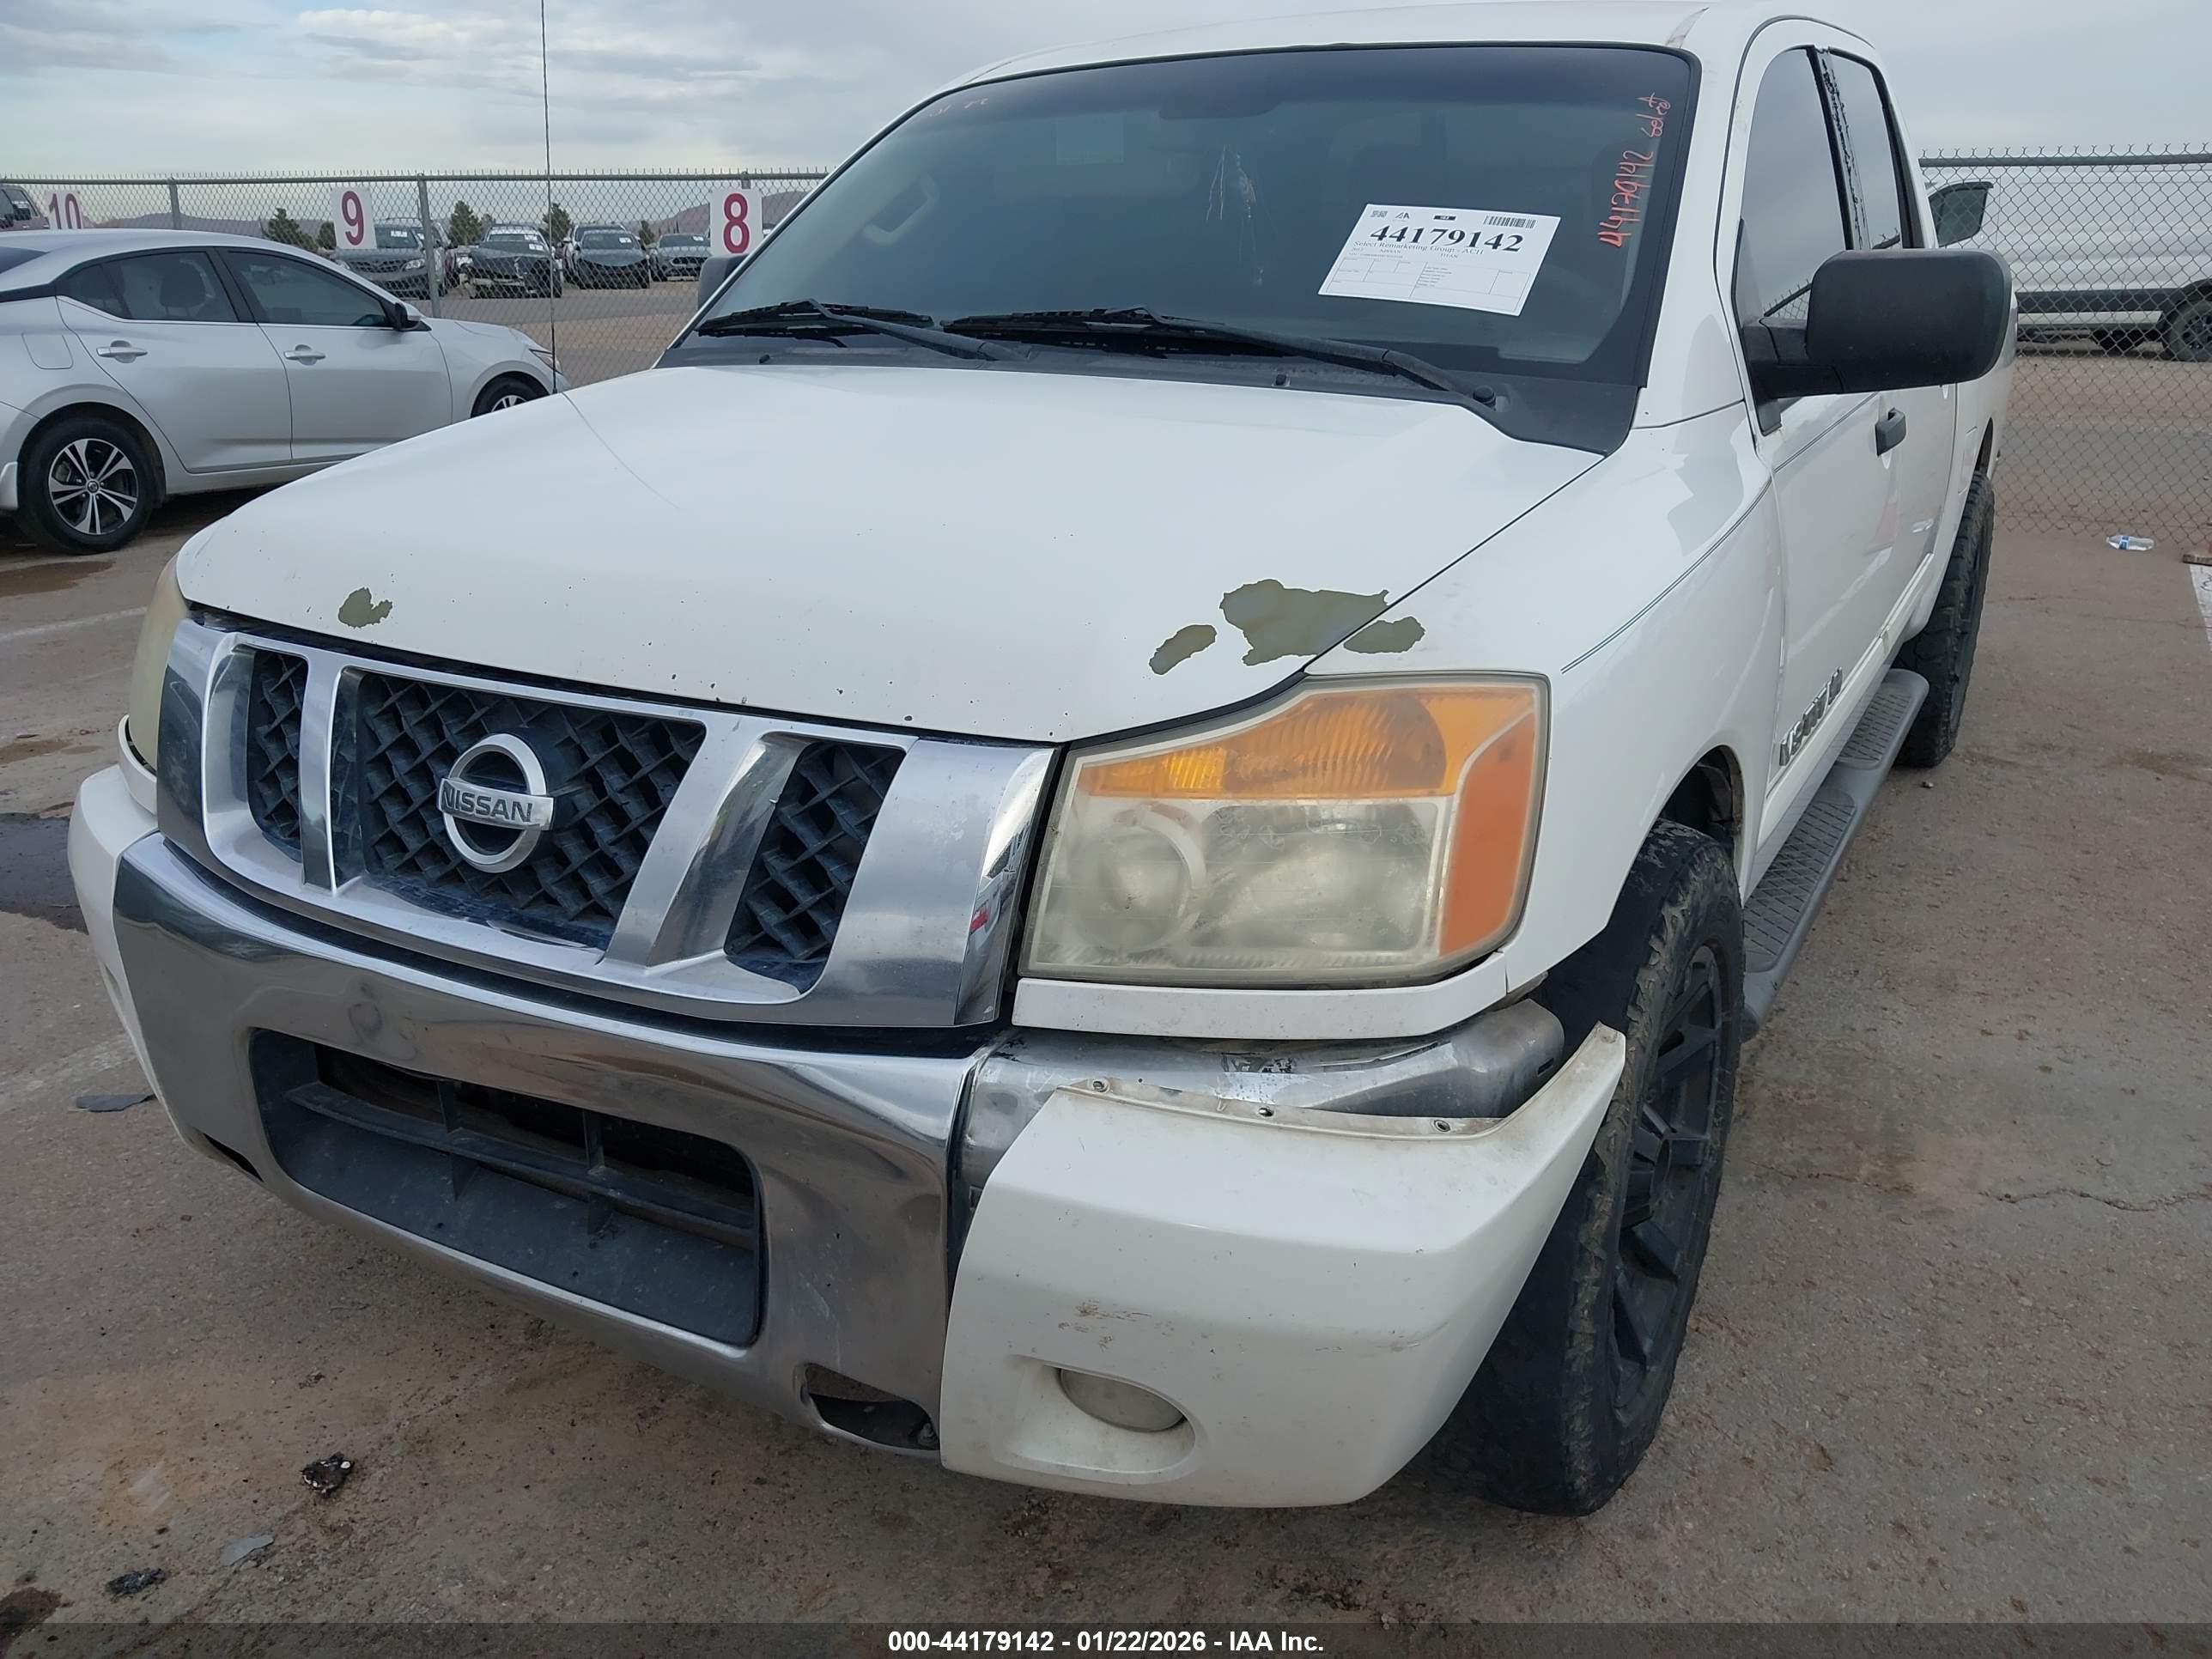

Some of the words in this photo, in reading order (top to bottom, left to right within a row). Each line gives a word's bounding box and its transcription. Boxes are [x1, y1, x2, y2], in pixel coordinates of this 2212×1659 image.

[341, 191, 366, 246] 9
[722, 192, 750, 254] 8
[1370, 225, 1524, 252] 44179142
[441, 782, 532, 823] NISSAN
